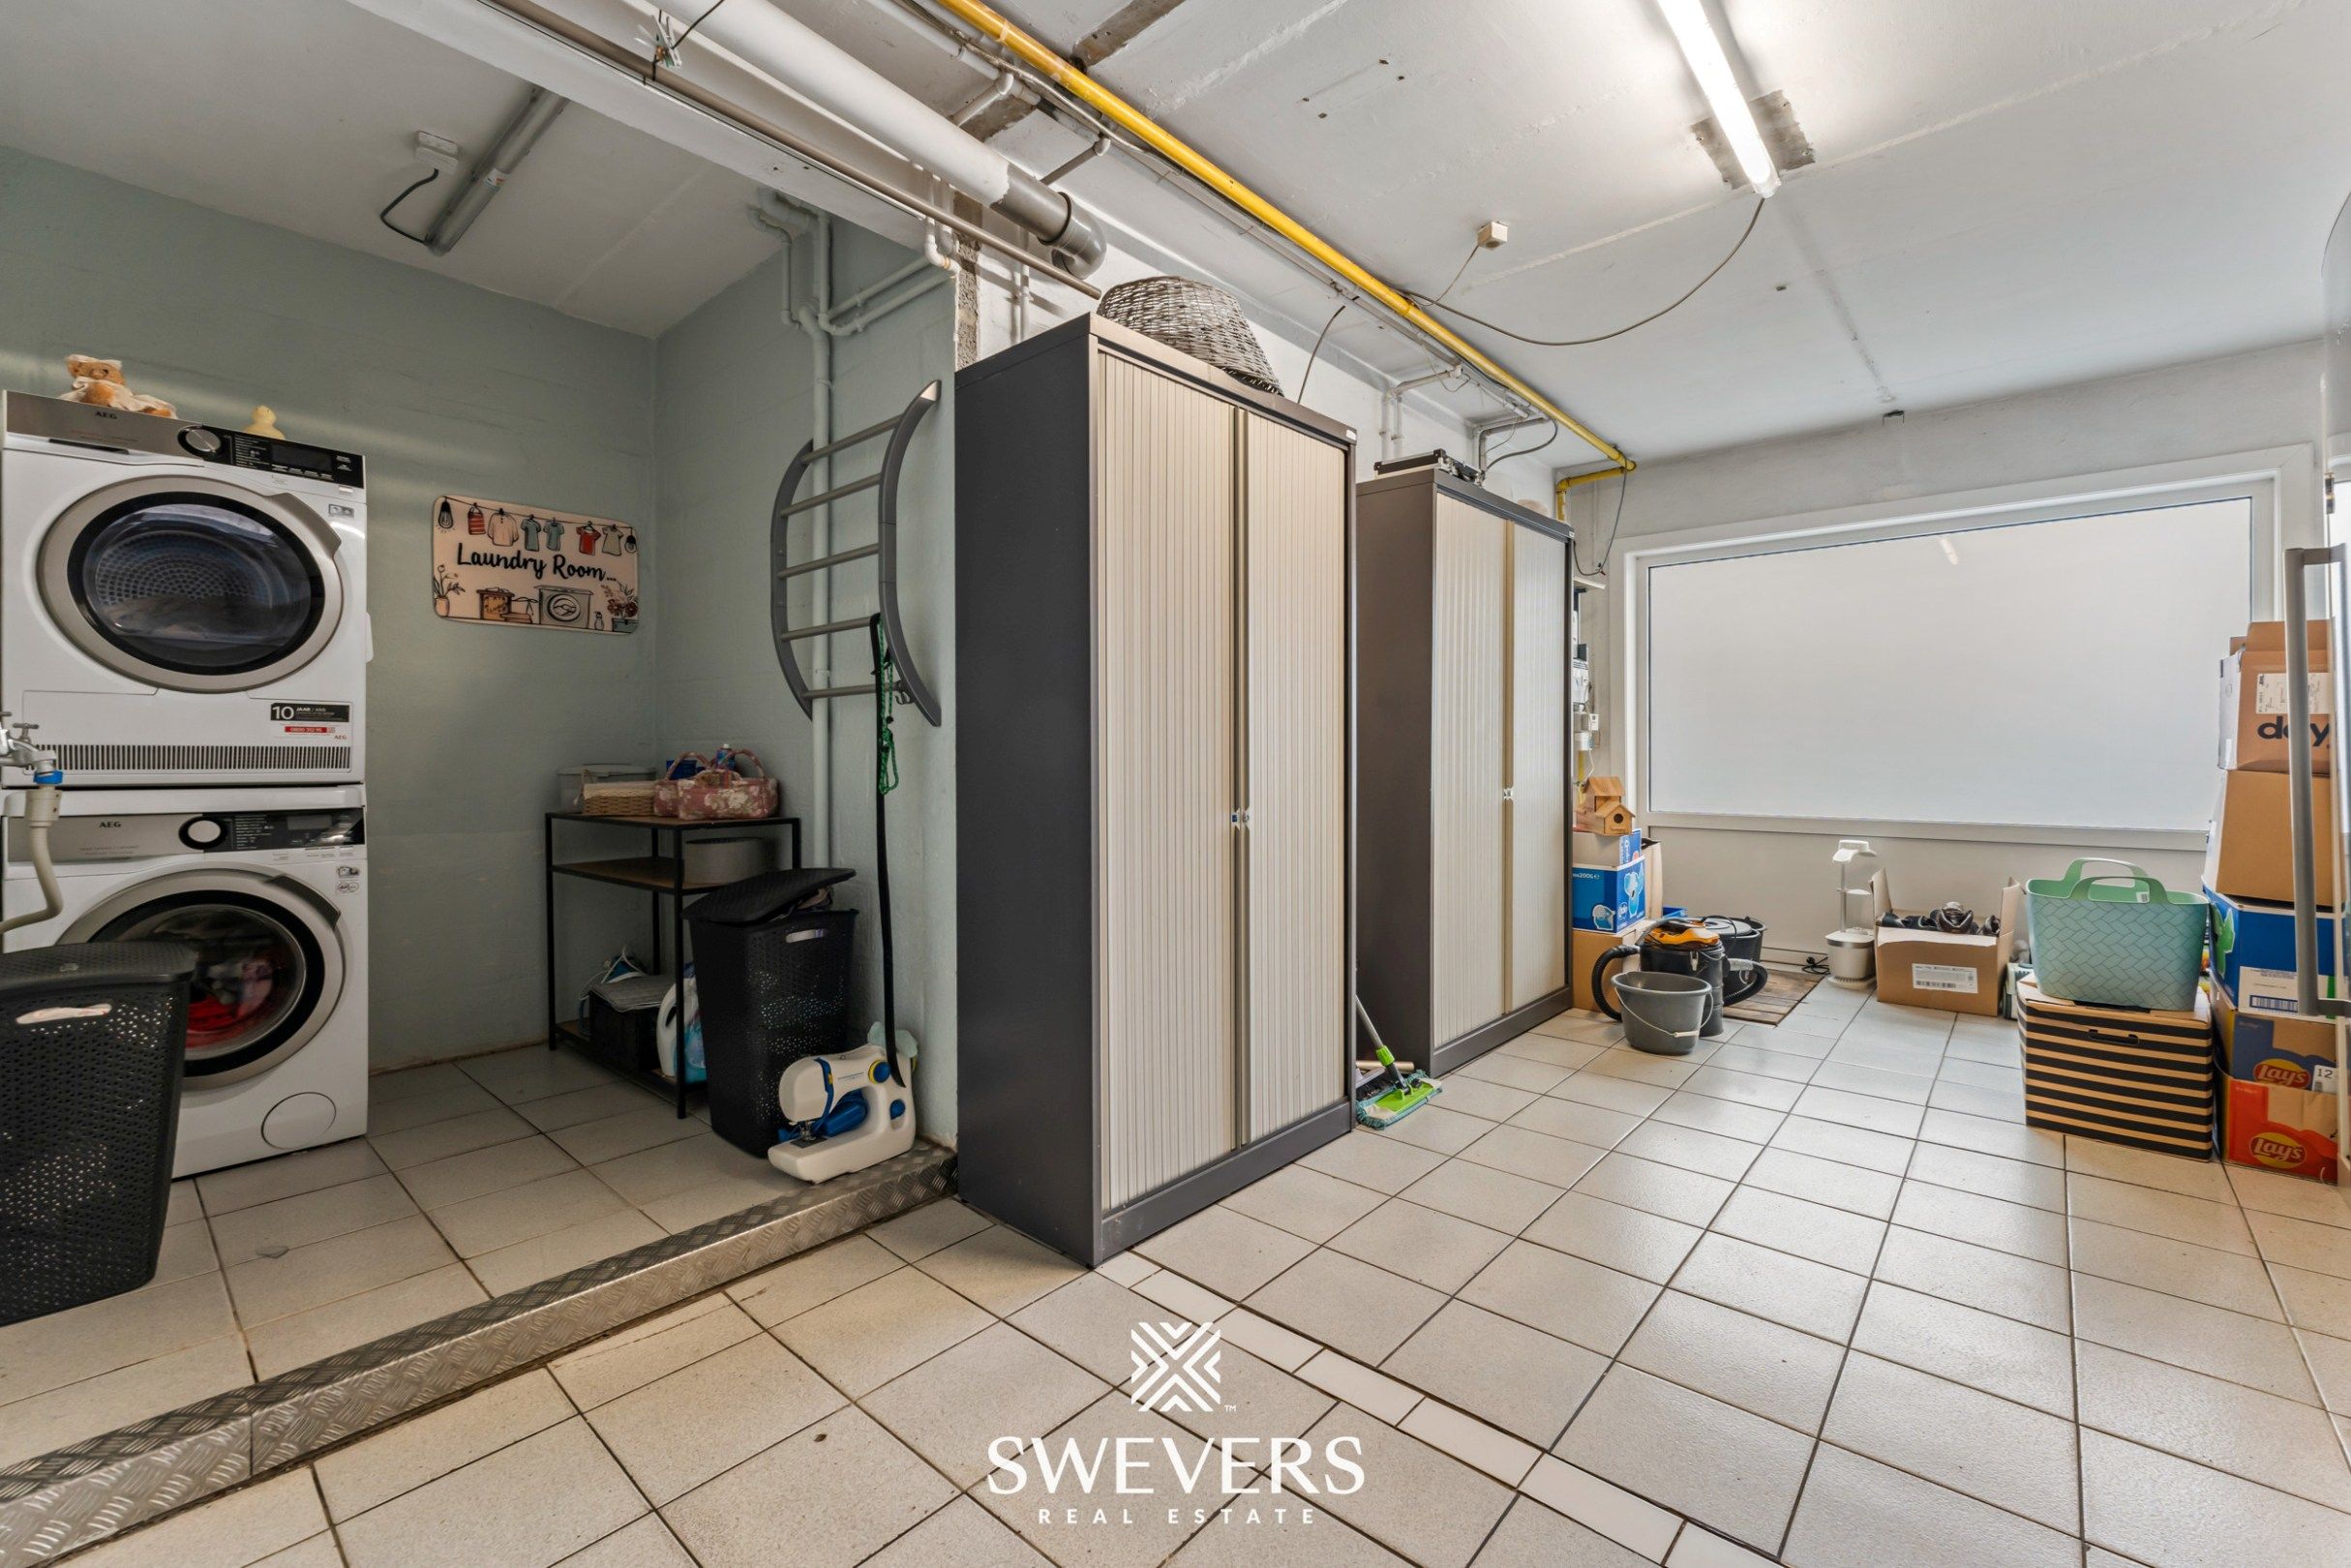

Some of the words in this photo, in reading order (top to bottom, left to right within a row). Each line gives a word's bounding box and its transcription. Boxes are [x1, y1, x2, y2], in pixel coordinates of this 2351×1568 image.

[95, 410, 117, 420] AEG
[457, 542, 547, 581] Laundry
[272, 706, 295, 720] 10
[2257, 715, 2330, 747] dy
[2317, 1068, 2334, 1080] 12
